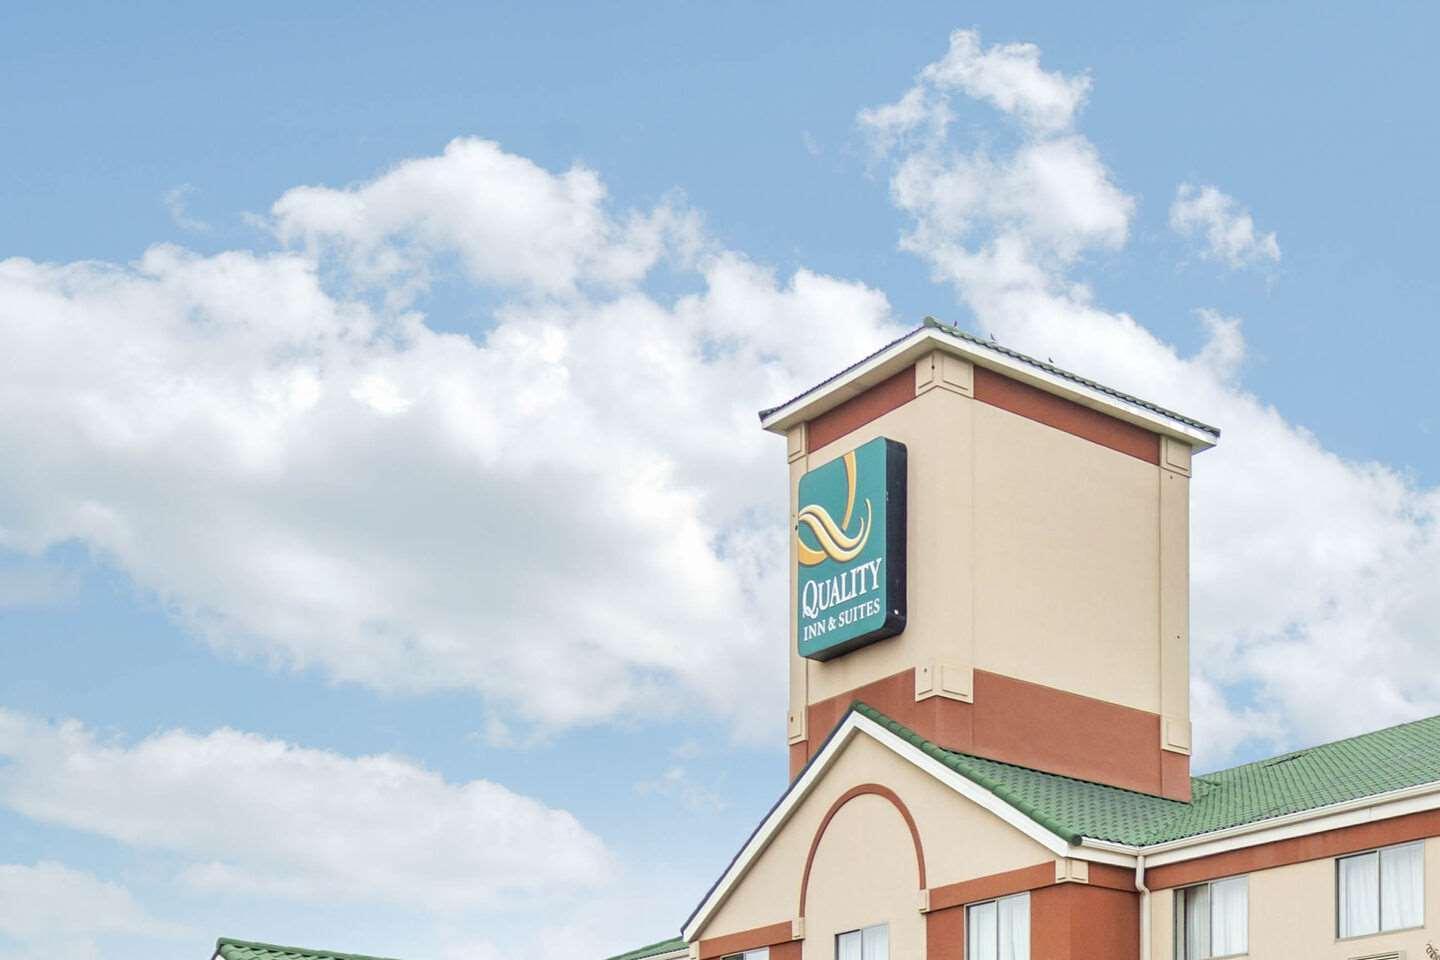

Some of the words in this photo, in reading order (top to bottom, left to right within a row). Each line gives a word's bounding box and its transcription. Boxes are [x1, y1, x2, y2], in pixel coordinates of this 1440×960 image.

[802, 557, 882, 619] QUALITY
[803, 619, 827, 642] INN
[828, 616, 838, 631] &
[838, 598, 880, 627] SUITES
